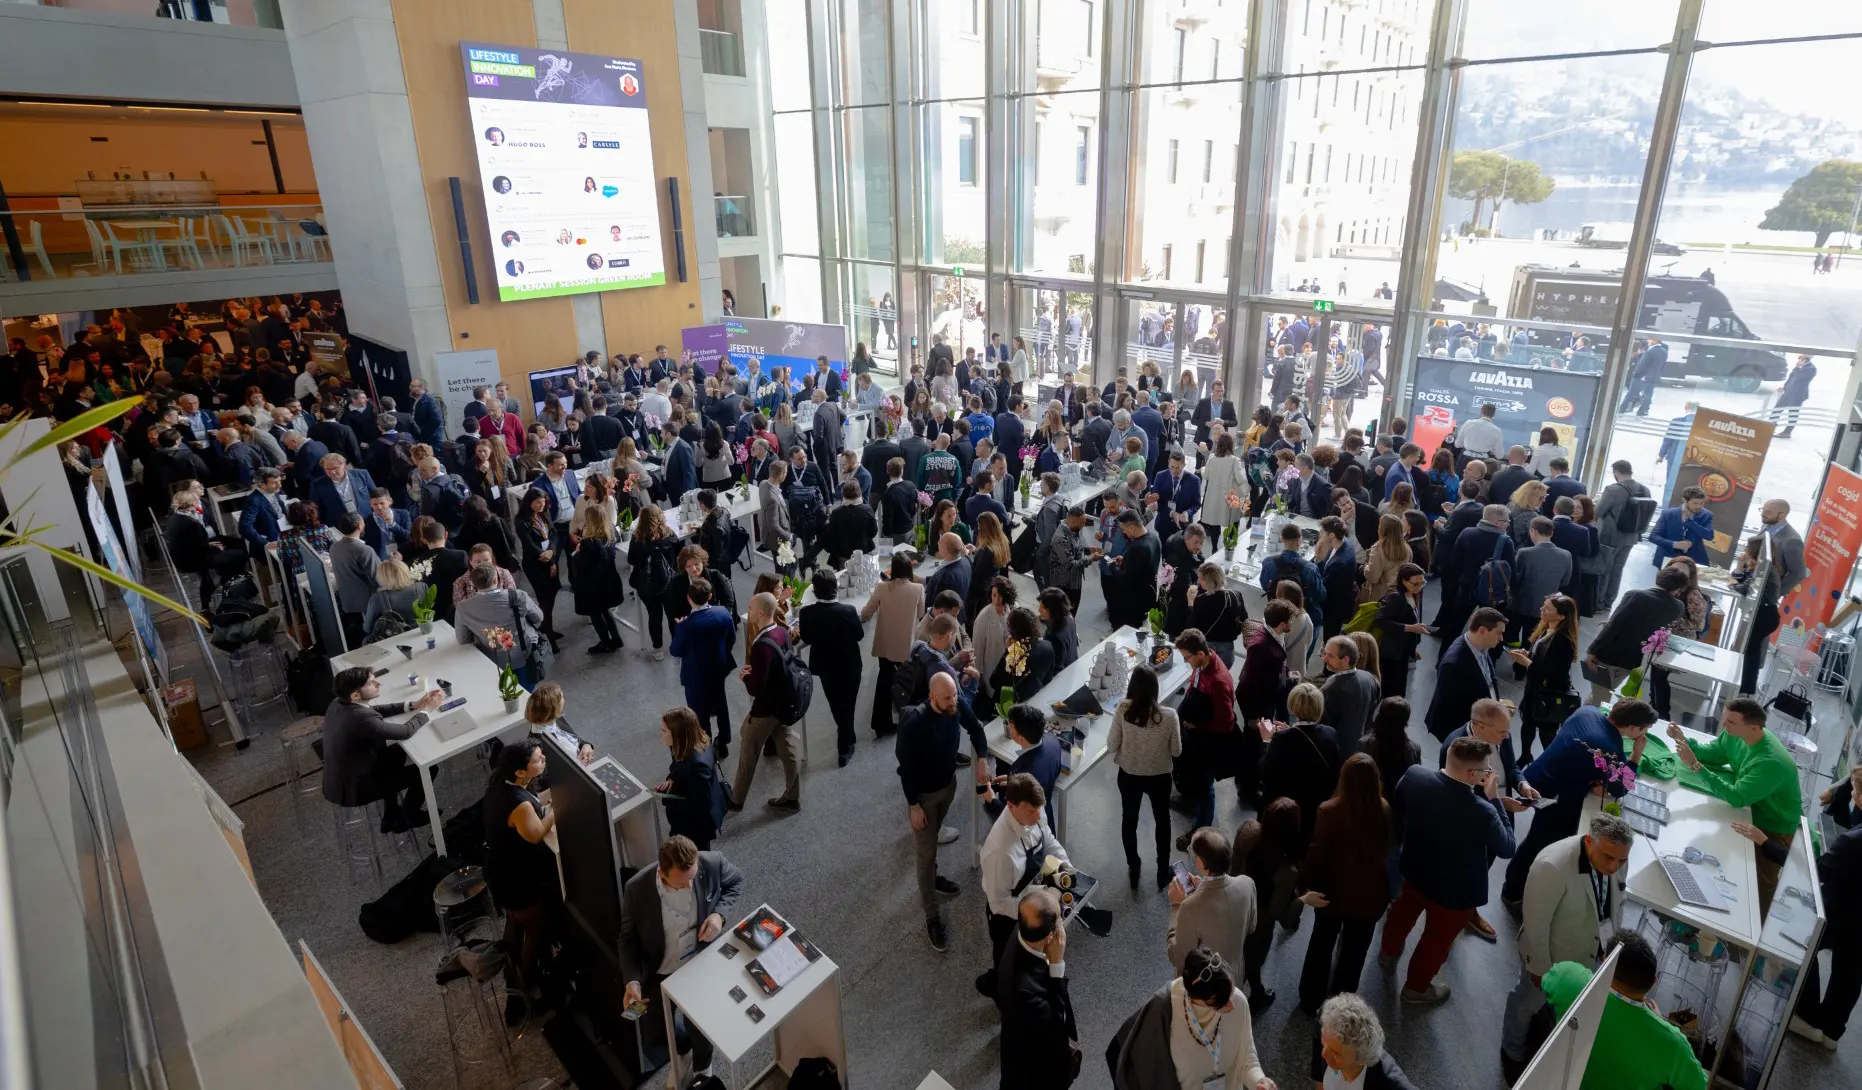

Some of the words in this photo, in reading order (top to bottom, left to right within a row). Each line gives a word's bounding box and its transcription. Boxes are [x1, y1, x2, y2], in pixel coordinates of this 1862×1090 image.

[470, 50, 517, 63] LIFESTYLE
[473, 62, 532, 76] INNOVATION
[475, 75, 494, 84] DAY
[514, 280, 556, 293] PLENARY
[559, 277, 596, 288] SESSION
[598, 275, 627, 285] GREEN
[627, 272, 652, 281] ROOM
[1468, 371, 1533, 389] LAVAZZA
[461, 384, 492, 392] chae
[1417, 392, 1459, 404] ROSSA
[1707, 420, 1756, 438] LAVAZZA
[926, 456, 955, 464] SUNSET
[1837, 485, 1861, 503] cegid
[1815, 528, 1833, 545] Live
[1832, 540, 1850, 558] Store
